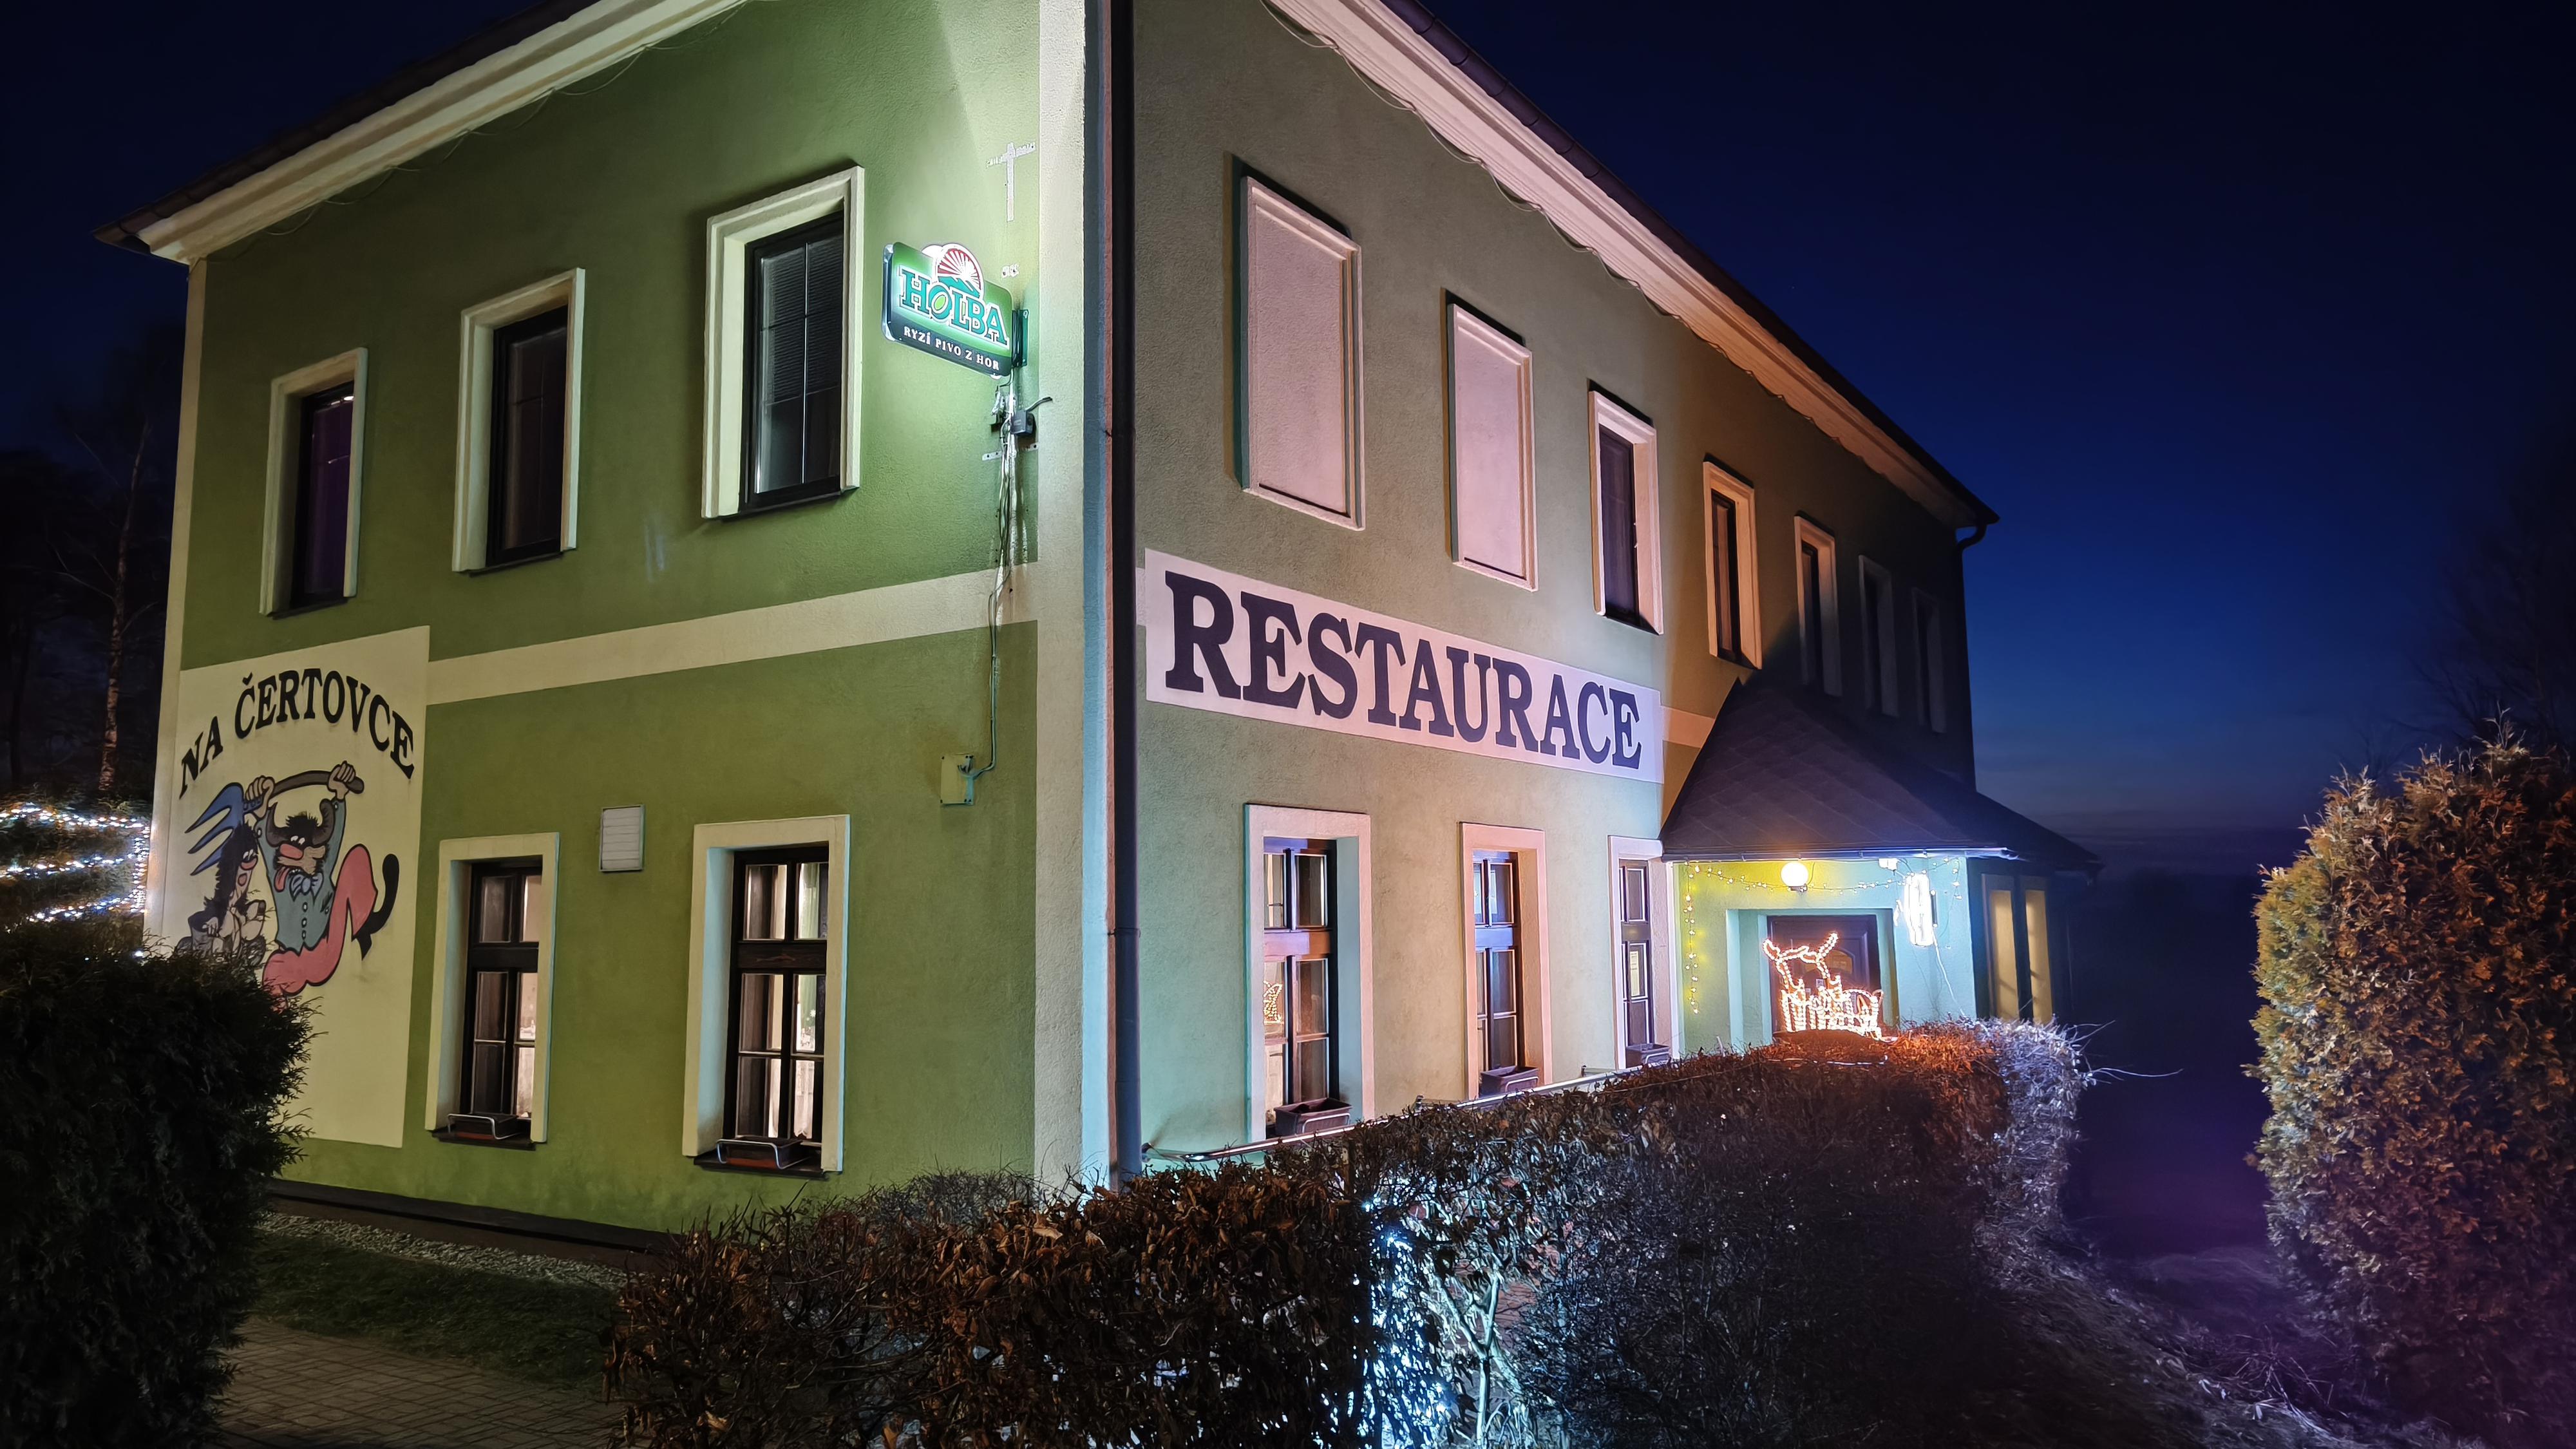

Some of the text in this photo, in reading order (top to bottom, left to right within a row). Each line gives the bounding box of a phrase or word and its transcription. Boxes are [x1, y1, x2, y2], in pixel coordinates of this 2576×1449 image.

[900, 267, 1008, 346] HOLBA
[904, 326, 999, 370] RYZÍ PIVO Z HOR
[1165, 571, 1641, 770] RESTAURACE
[179, 668, 414, 799] NA ČERTOVCE
